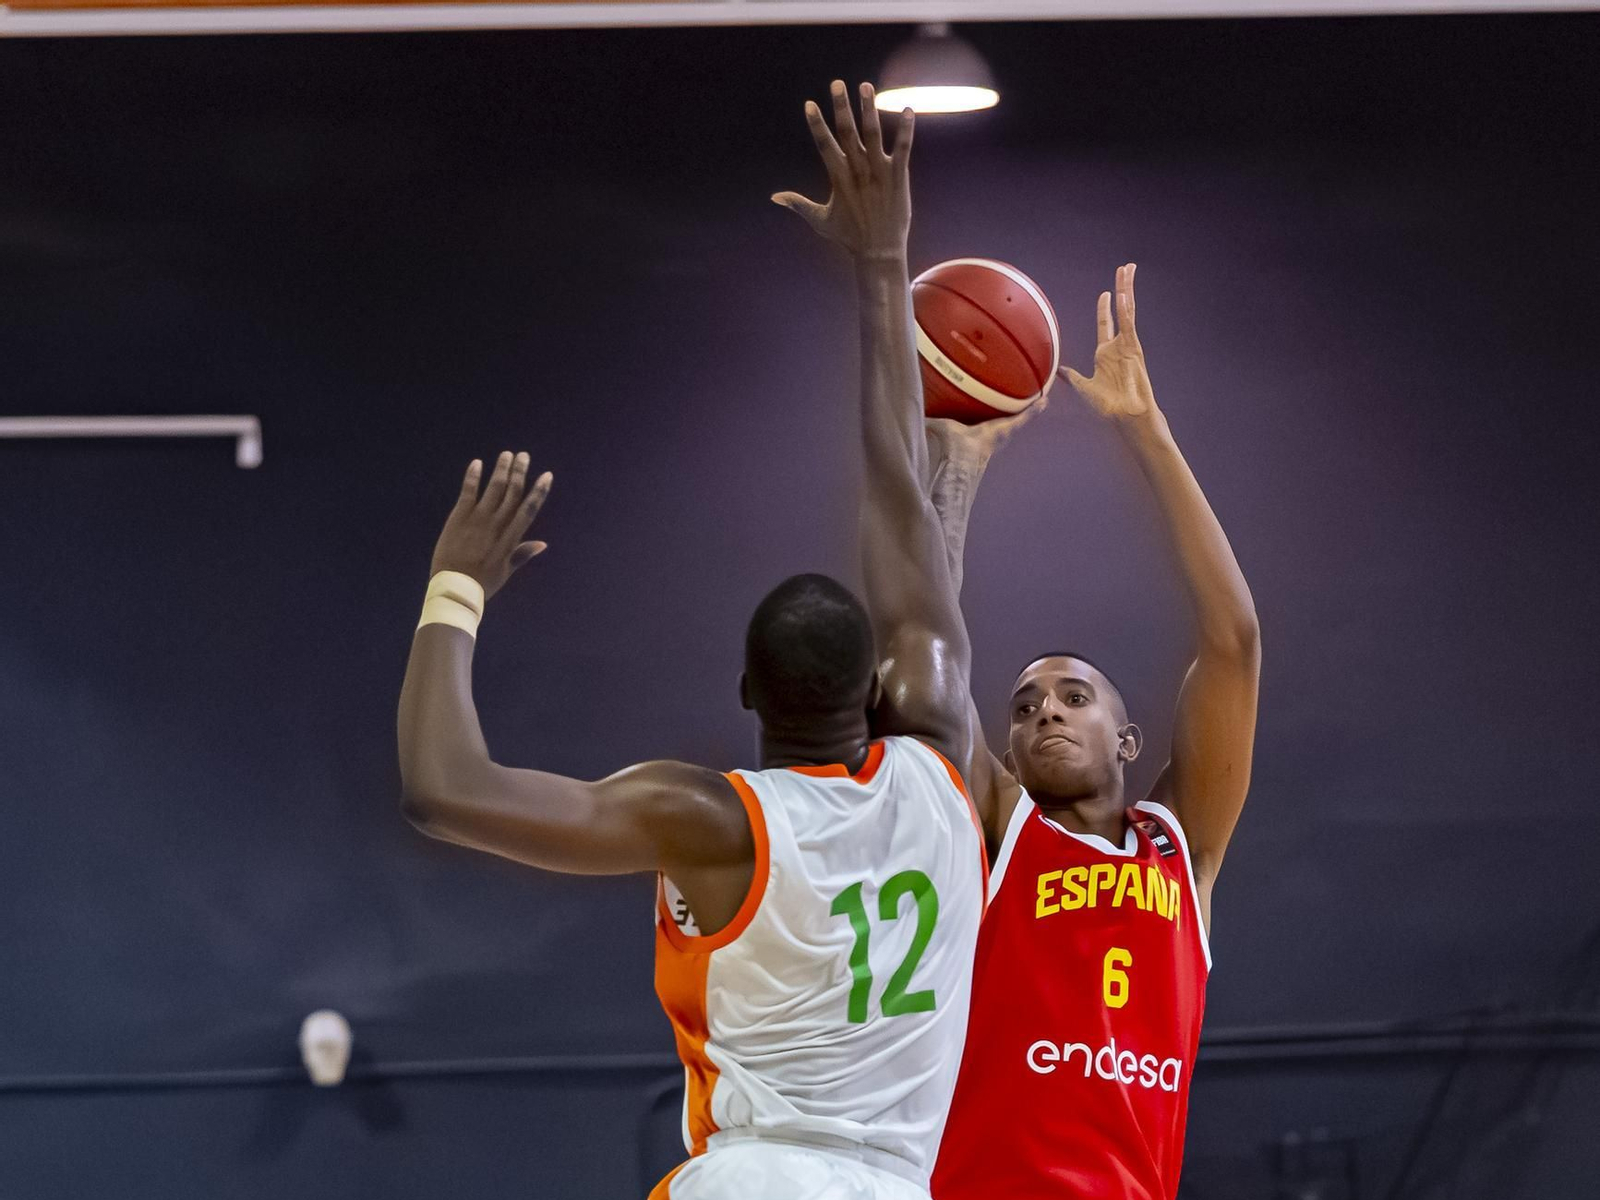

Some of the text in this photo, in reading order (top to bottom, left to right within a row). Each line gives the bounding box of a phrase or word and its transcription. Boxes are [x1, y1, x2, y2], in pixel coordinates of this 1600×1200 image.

[830, 870, 939, 1023] 12
[1103, 947, 1133, 1009] 6
[1026, 1037, 1182, 1092] endesa
